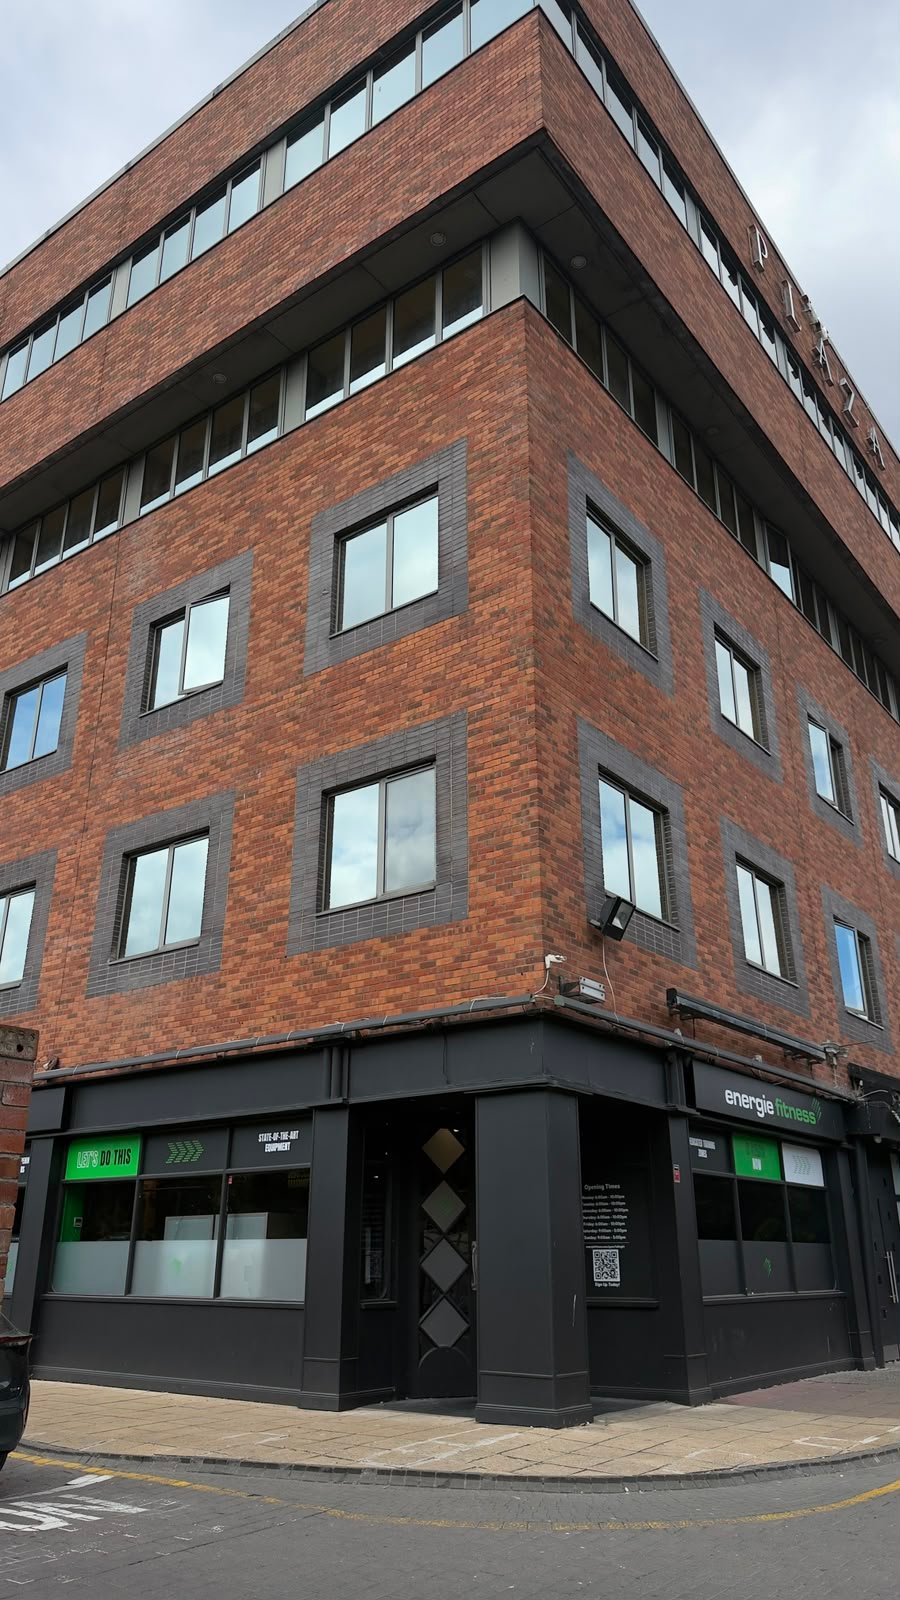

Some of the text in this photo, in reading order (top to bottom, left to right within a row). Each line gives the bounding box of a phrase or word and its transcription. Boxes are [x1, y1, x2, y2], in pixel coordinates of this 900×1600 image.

[724, 1089, 817, 1124] energie fitness
[258, 1130, 299, 1142] STATE-OF-THE-ART
[77, 1148, 131, 1168] LET'S DO THIS
